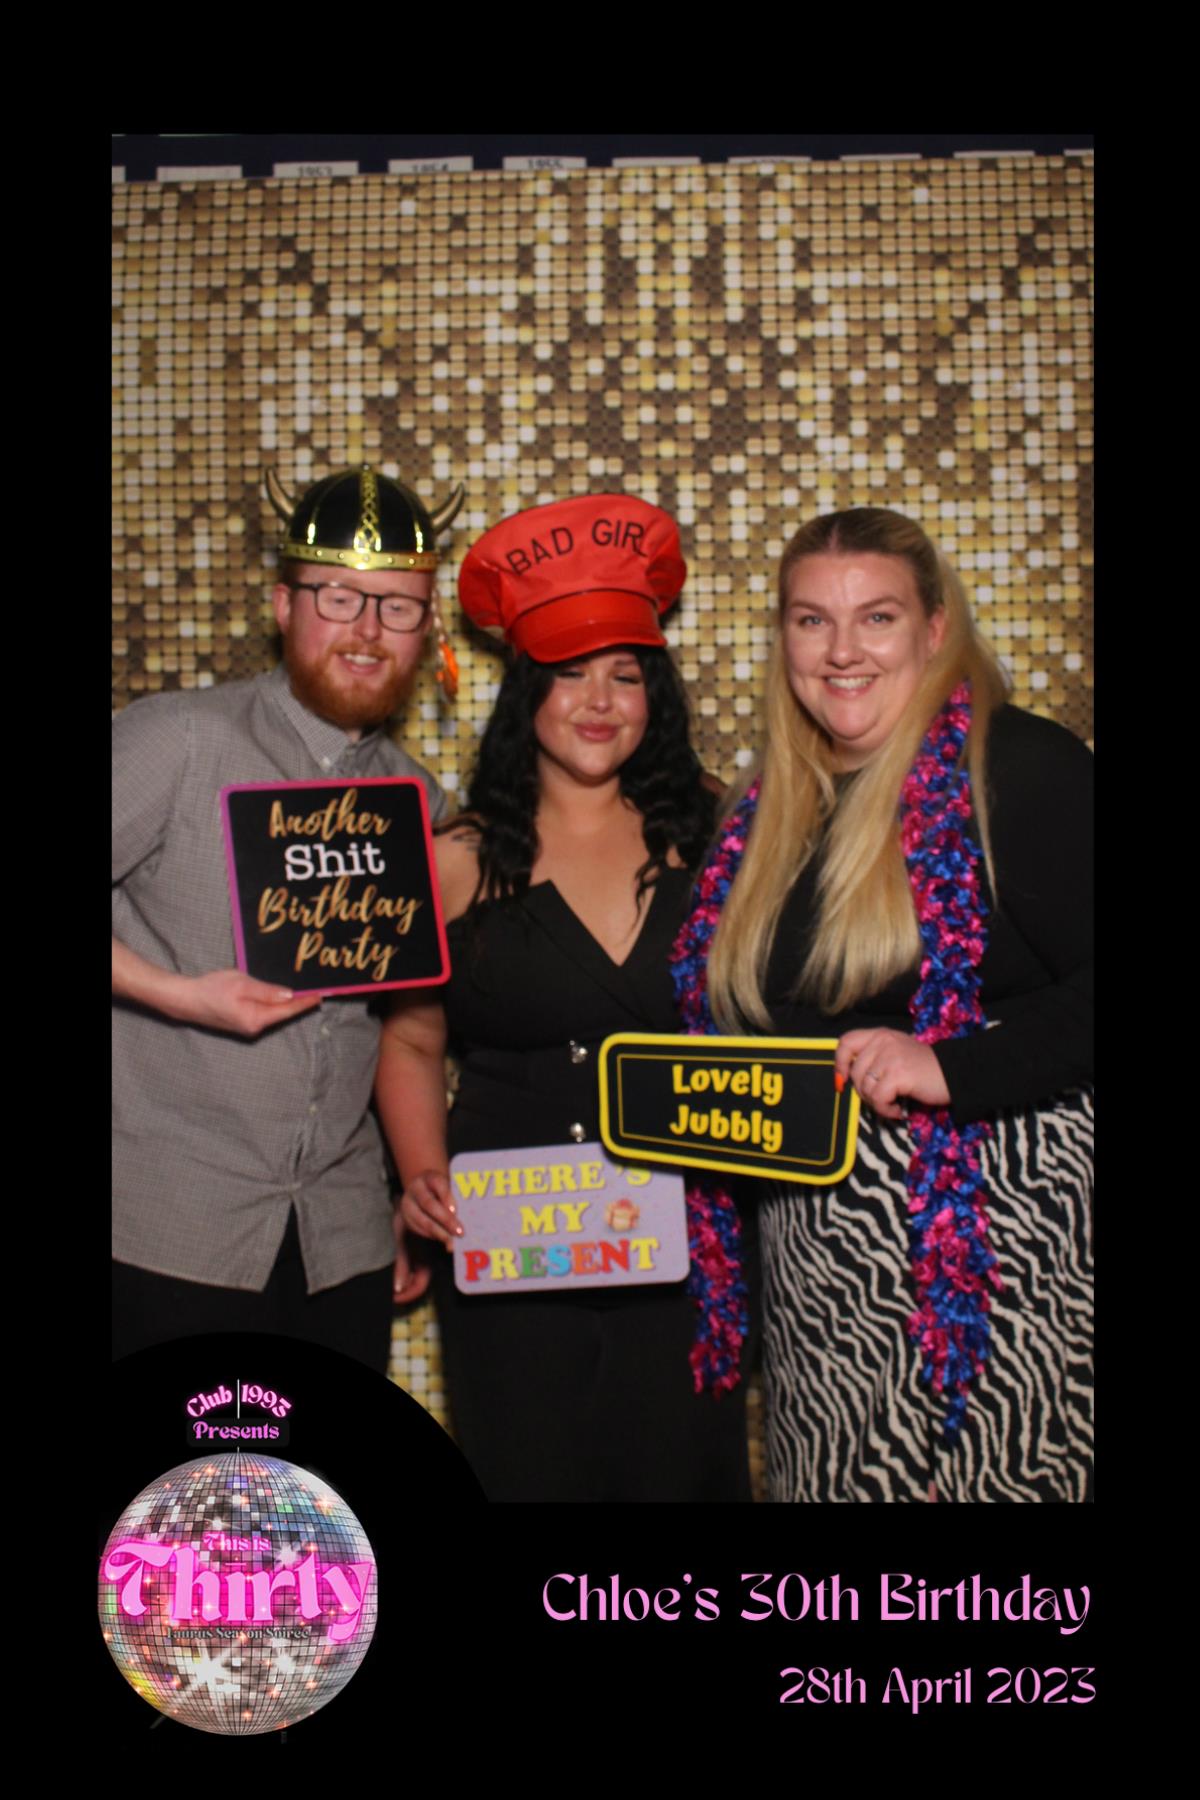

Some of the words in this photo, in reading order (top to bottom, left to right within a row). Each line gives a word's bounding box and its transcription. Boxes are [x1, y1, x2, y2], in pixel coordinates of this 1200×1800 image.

[506, 526, 574, 576] BAD
[270, 788, 392, 841] Another
[284, 841, 386, 881] Shit
[257, 875, 423, 935] Birthday
[294, 926, 398, 982] Party
[672, 1064, 784, 1106] Lovely
[669, 1105, 784, 1153] Jubbly
[519, 1202, 591, 1236] MY
[464, 1238, 659, 1282] PRESENT
